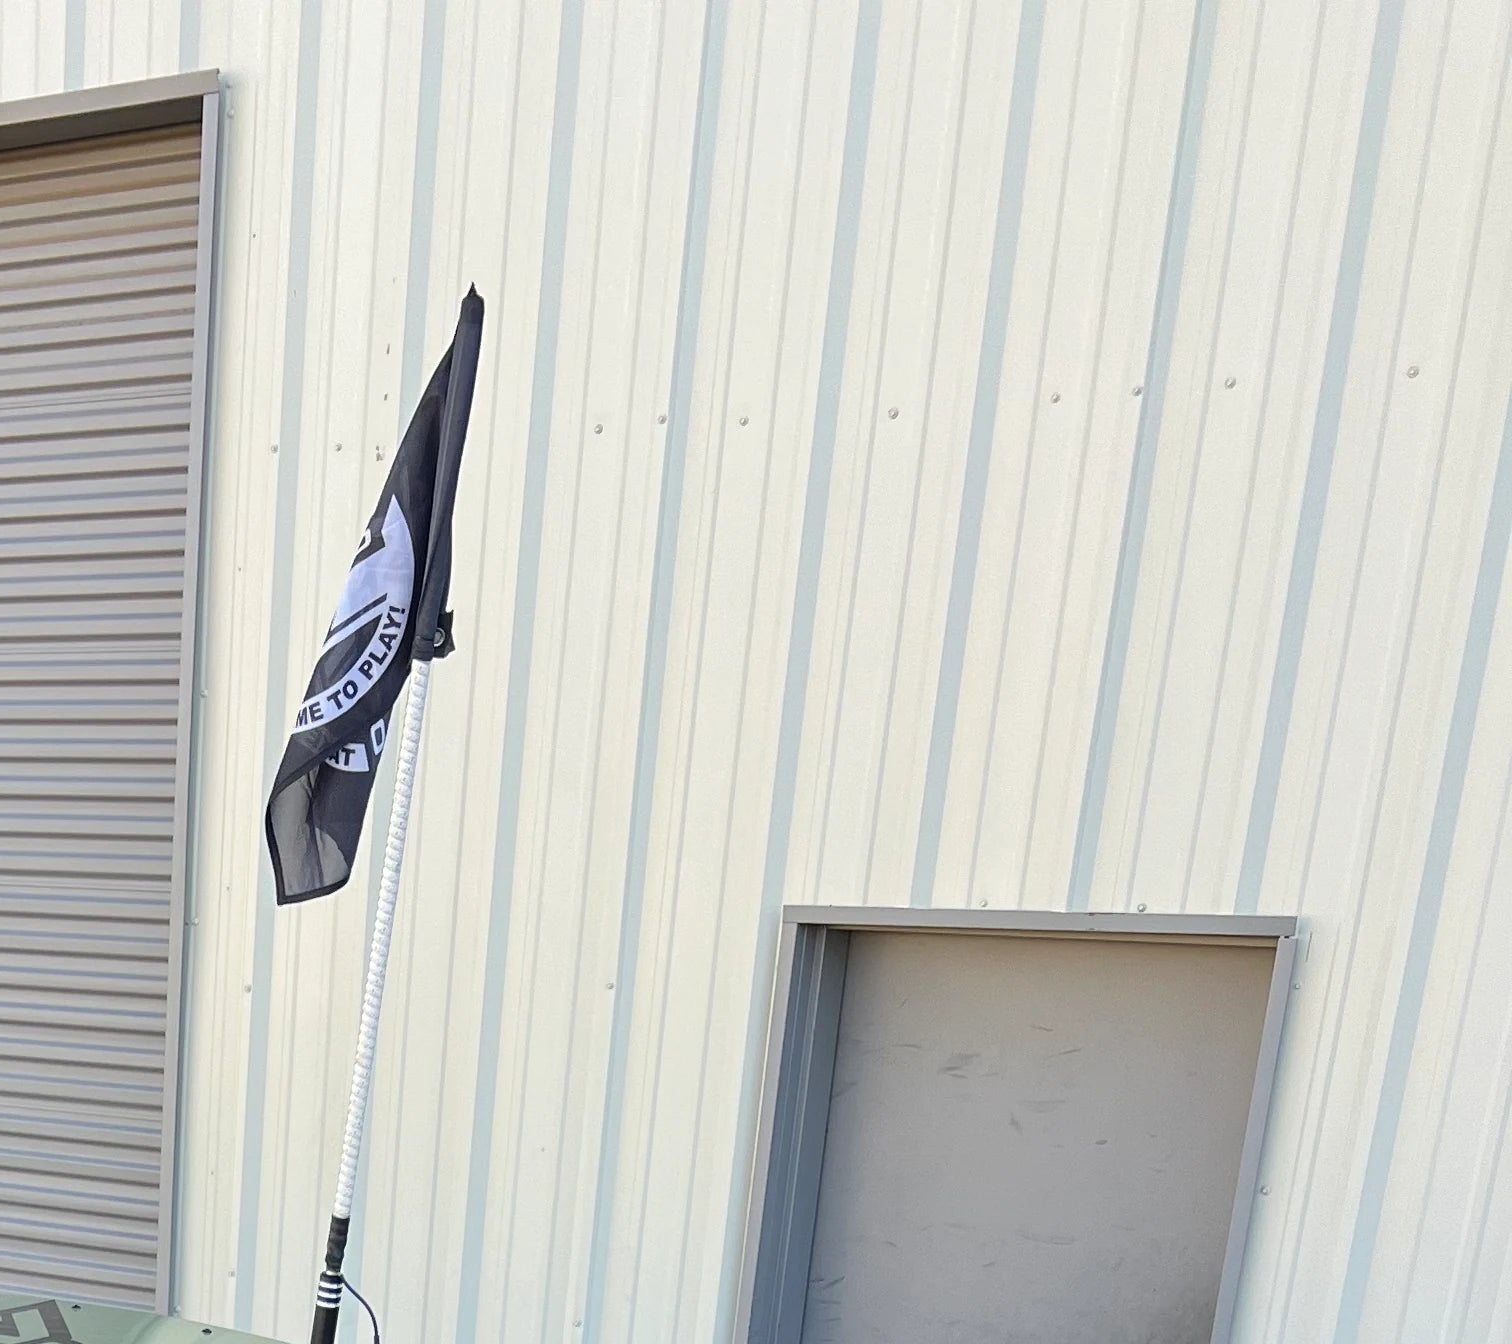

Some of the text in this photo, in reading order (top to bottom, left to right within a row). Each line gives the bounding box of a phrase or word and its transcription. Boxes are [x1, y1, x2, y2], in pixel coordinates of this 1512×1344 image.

[295, 605, 406, 728] ME TO PLAY!
